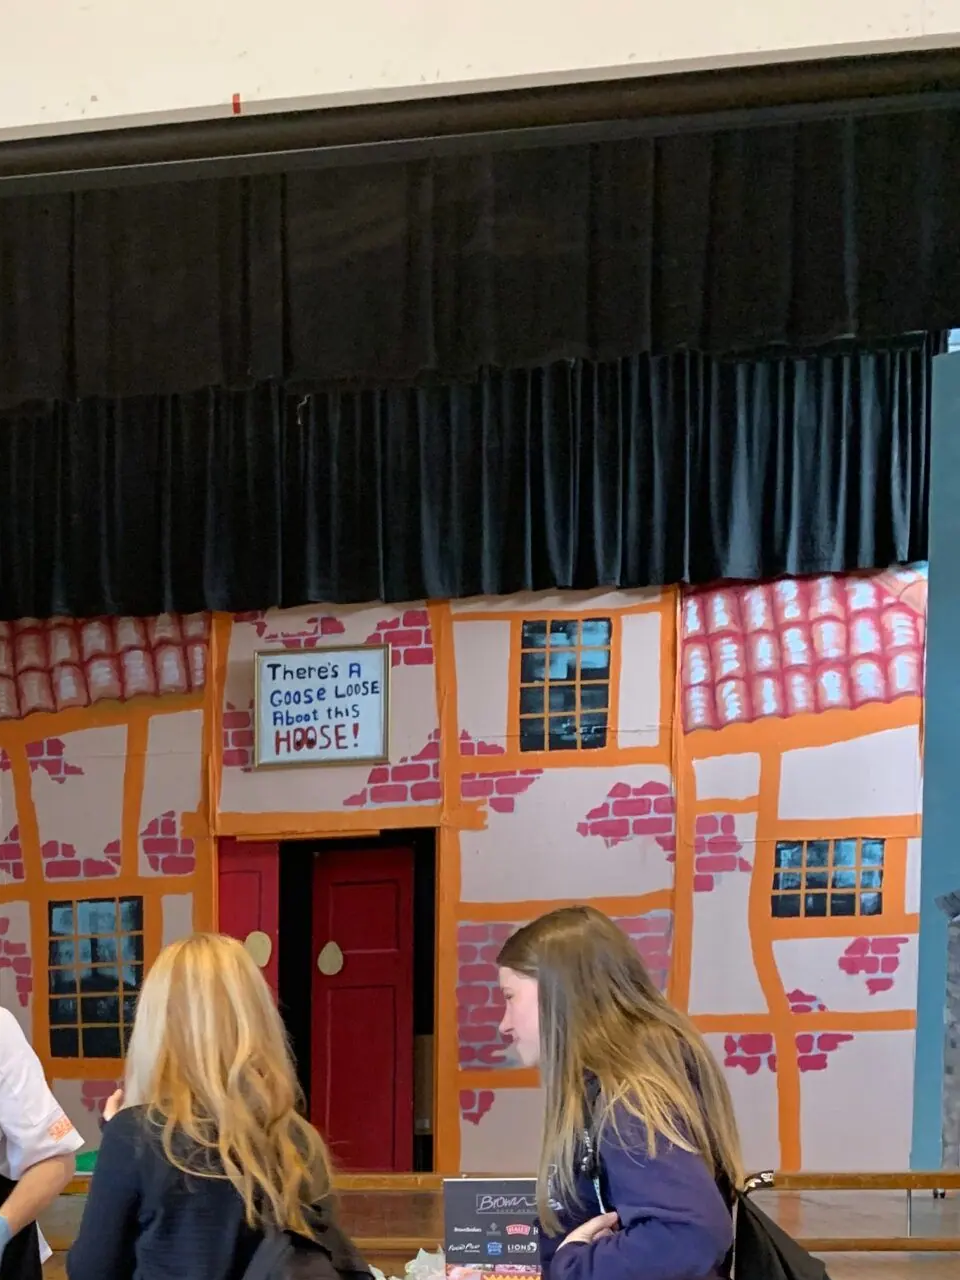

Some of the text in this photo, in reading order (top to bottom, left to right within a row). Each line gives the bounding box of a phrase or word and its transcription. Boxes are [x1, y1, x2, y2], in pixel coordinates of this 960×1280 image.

[267, 662, 361, 680] There's A
[335, 681, 380, 699] LOOSE
[275, 723, 360, 755] HOOSE!
